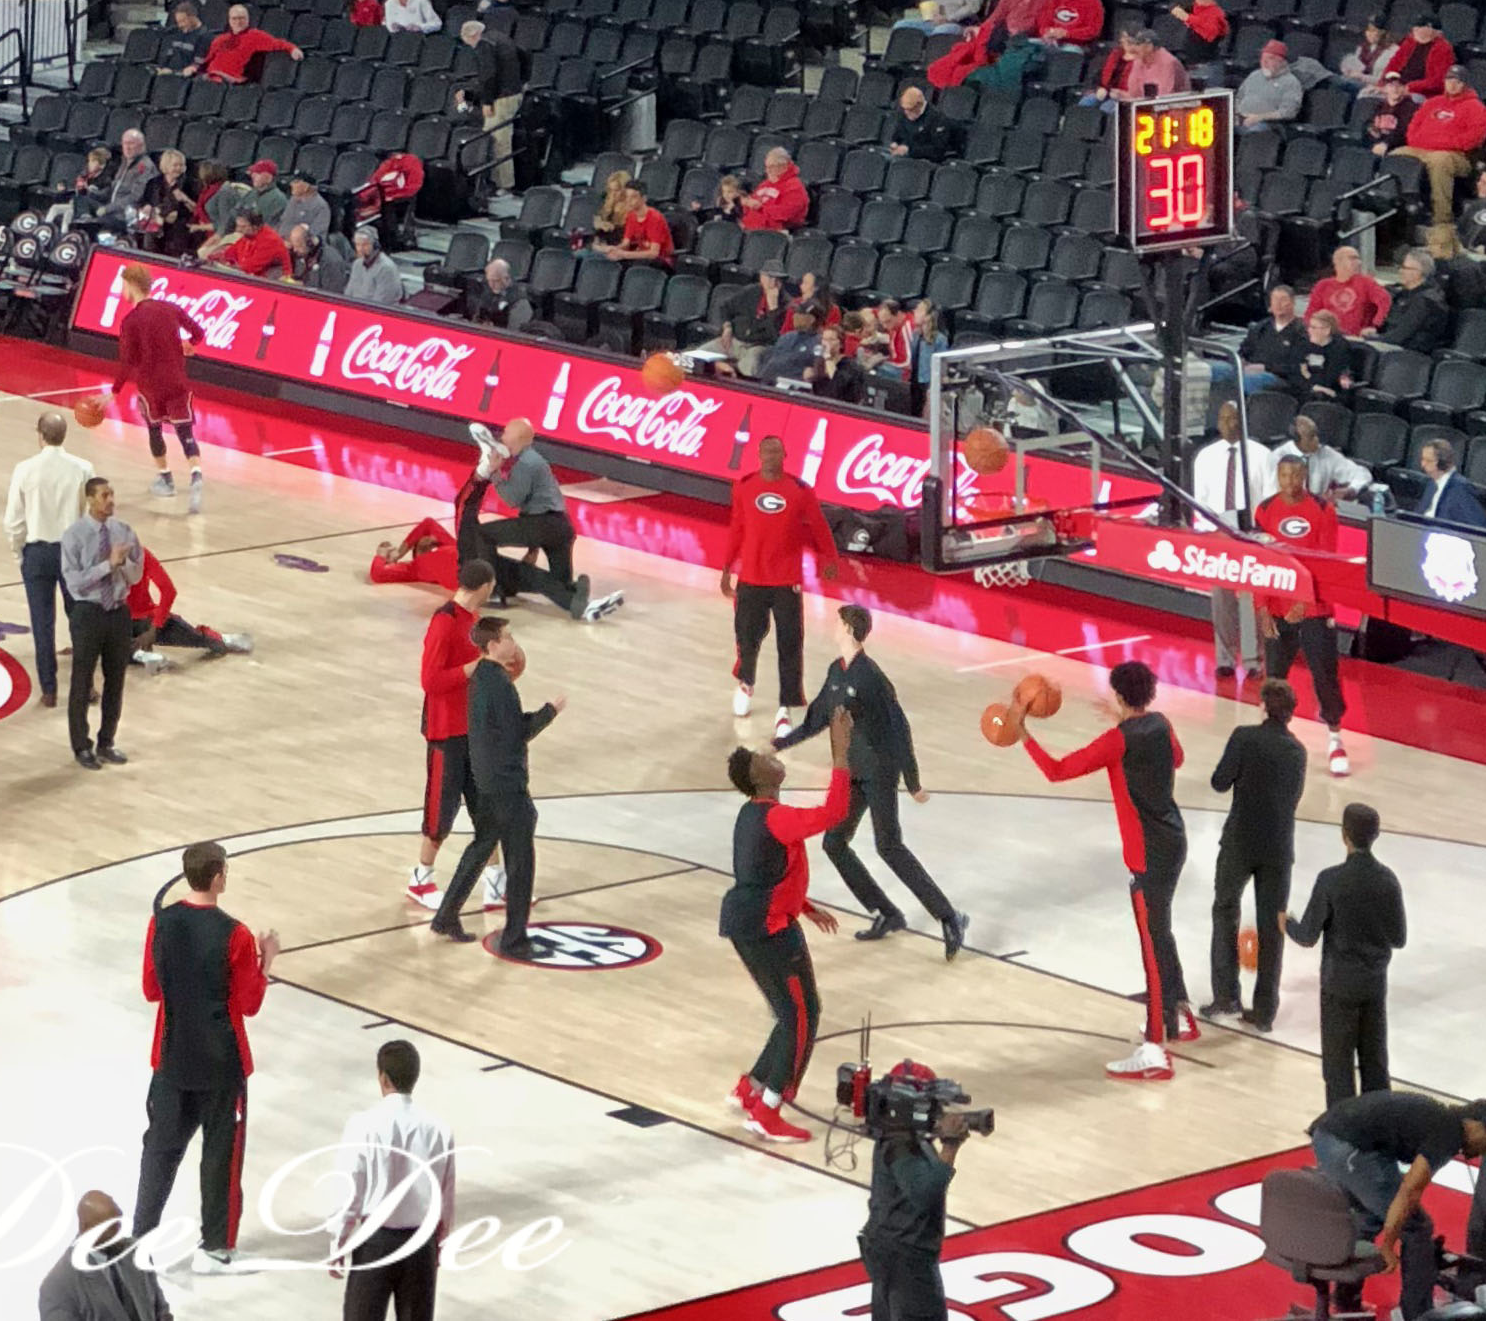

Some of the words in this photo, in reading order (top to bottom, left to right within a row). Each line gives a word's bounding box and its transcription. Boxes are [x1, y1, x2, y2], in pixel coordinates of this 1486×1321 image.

[1136, 108, 1215, 154] 21:18
[1149, 154, 1204, 227] 30
[342, 324, 475, 401] Coca-Cola
[577, 375, 723, 458] Coca-Cola
